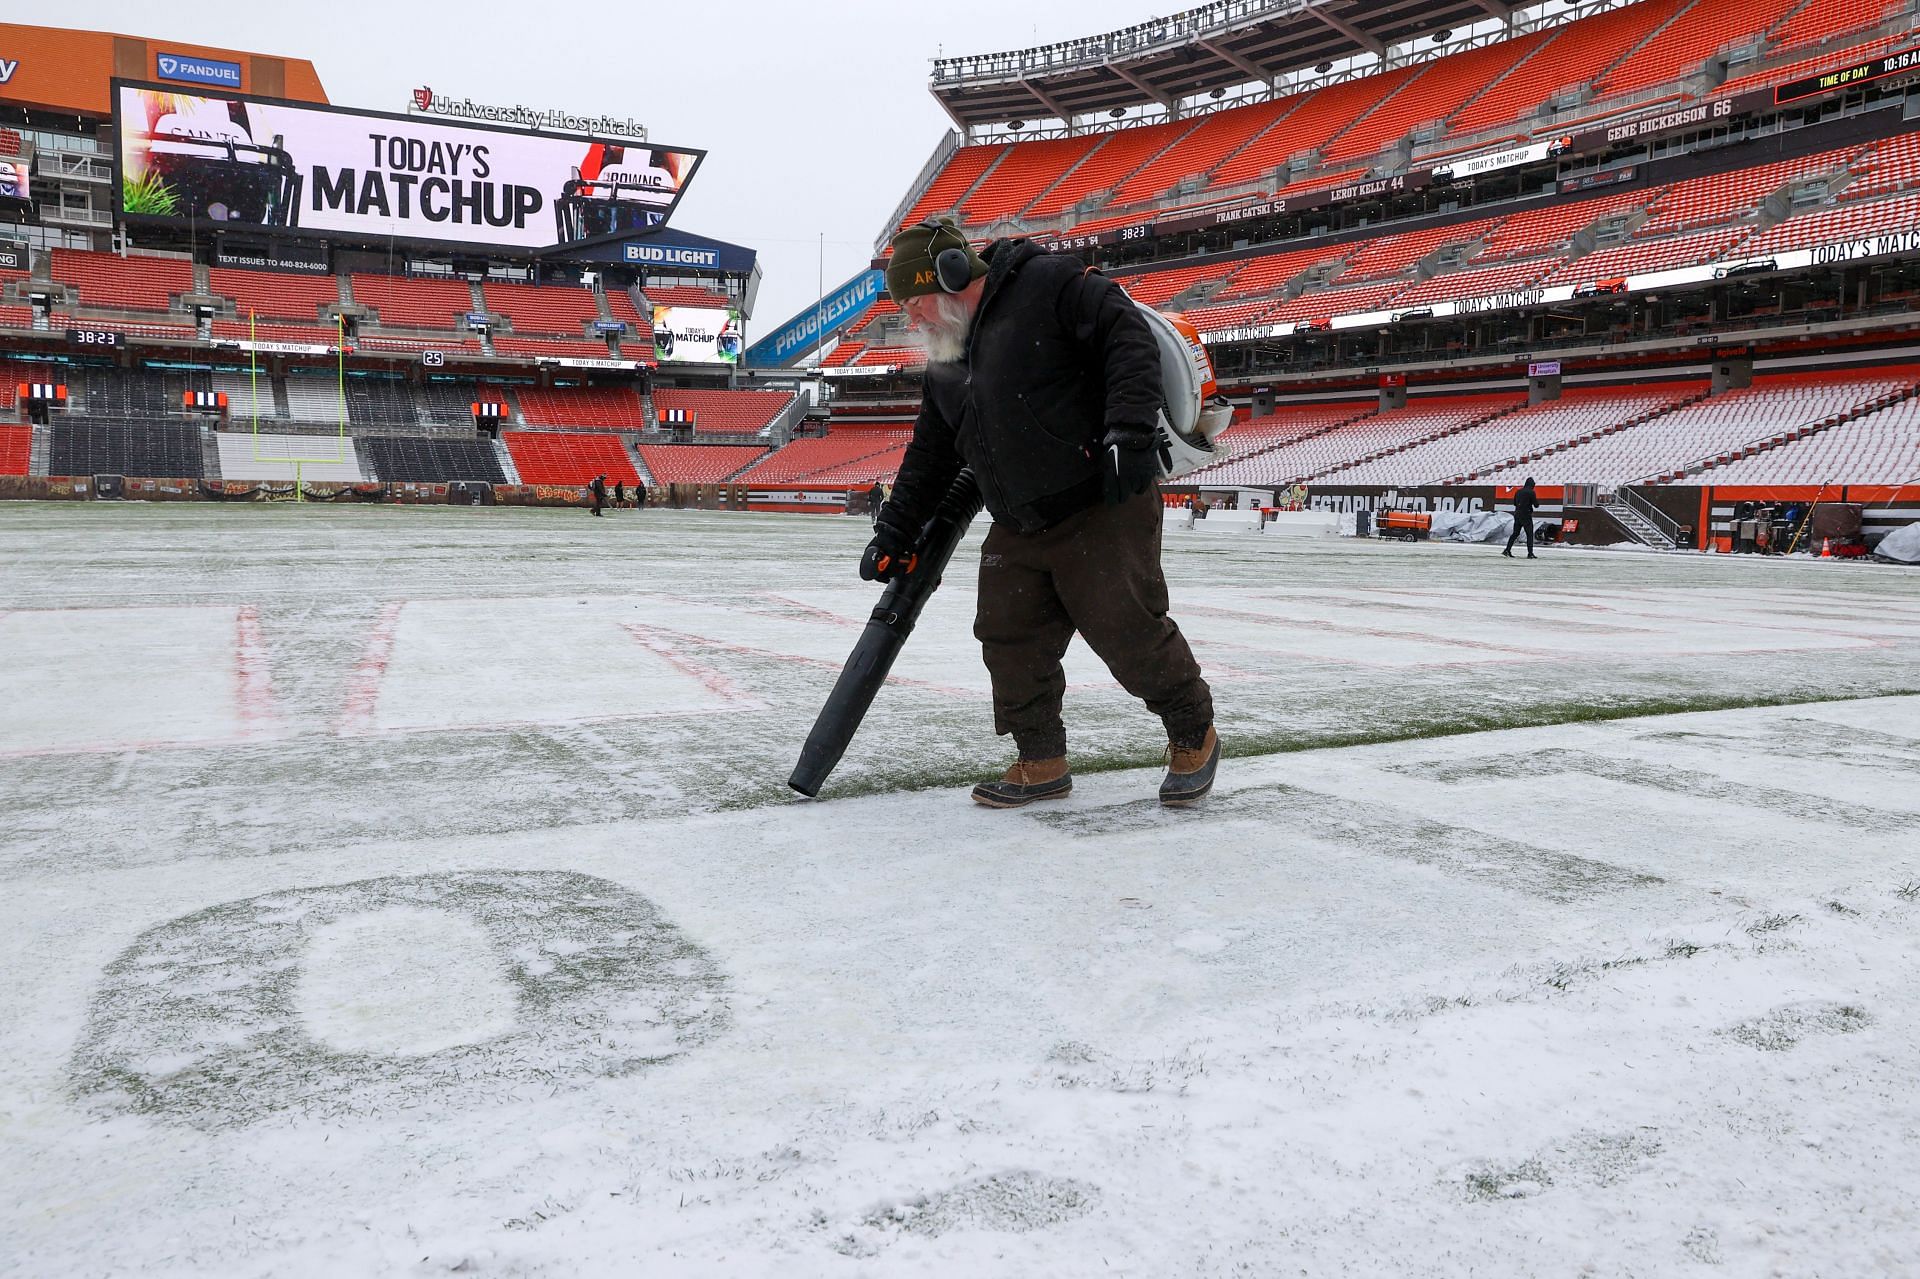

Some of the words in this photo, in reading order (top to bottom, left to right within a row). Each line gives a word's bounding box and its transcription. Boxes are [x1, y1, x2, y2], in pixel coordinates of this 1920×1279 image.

[180, 63, 239, 80] FANDUEL
[1819, 75, 1839, 88] TIME
[1840, 71, 1850, 82] OF
[1852, 66, 1869, 79] DAY
[1883, 54, 1908, 72] 10:16
[434, 96, 544, 129] University
[549, 109, 644, 137] Hospitals
[1607, 126, 1637, 142] GENE
[1640, 107, 1707, 134] HICKERSON
[1713, 99, 1731, 118] 66
[368, 133, 490, 179] TODAY'S
[1497, 150, 1530, 166] MATCHUP
[312, 165, 543, 229] MATCHUP
[1331, 186, 1358, 201] LEROY
[1359, 180, 1386, 196] KELLY
[1390, 176, 1404, 189] 44
[1216, 209, 1241, 223] FRANK
[1242, 203, 1271, 218] GATSKI
[1273, 201, 1286, 213] 52
[1122, 226, 1145, 240] 38:23
[627, 246, 664, 261] BUD
[666, 249, 716, 265] LIGHT
[1809, 239, 1871, 266] TODAY'S
[219, 255, 237, 264] TEXT
[239, 256, 265, 266] ISSUES
[267, 258, 278, 267] TO
[279, 260, 327, 271] 440-824-6000
[1453, 297, 1492, 315] TODAY'S
[1495, 289, 1545, 310] MATCHUP
[775, 274, 877, 356] PROGRESSIVE
[77, 331, 115, 345] 38:23
[675, 333, 715, 343] MATCHUP
[685, 327, 705, 335] TODAY'S
[1206, 328, 1235, 344] TODAY'S
[1237, 325, 1274, 341] MATCHUP
[283, 343, 312, 352] MATCHUP
[426, 353, 441, 364] 25
